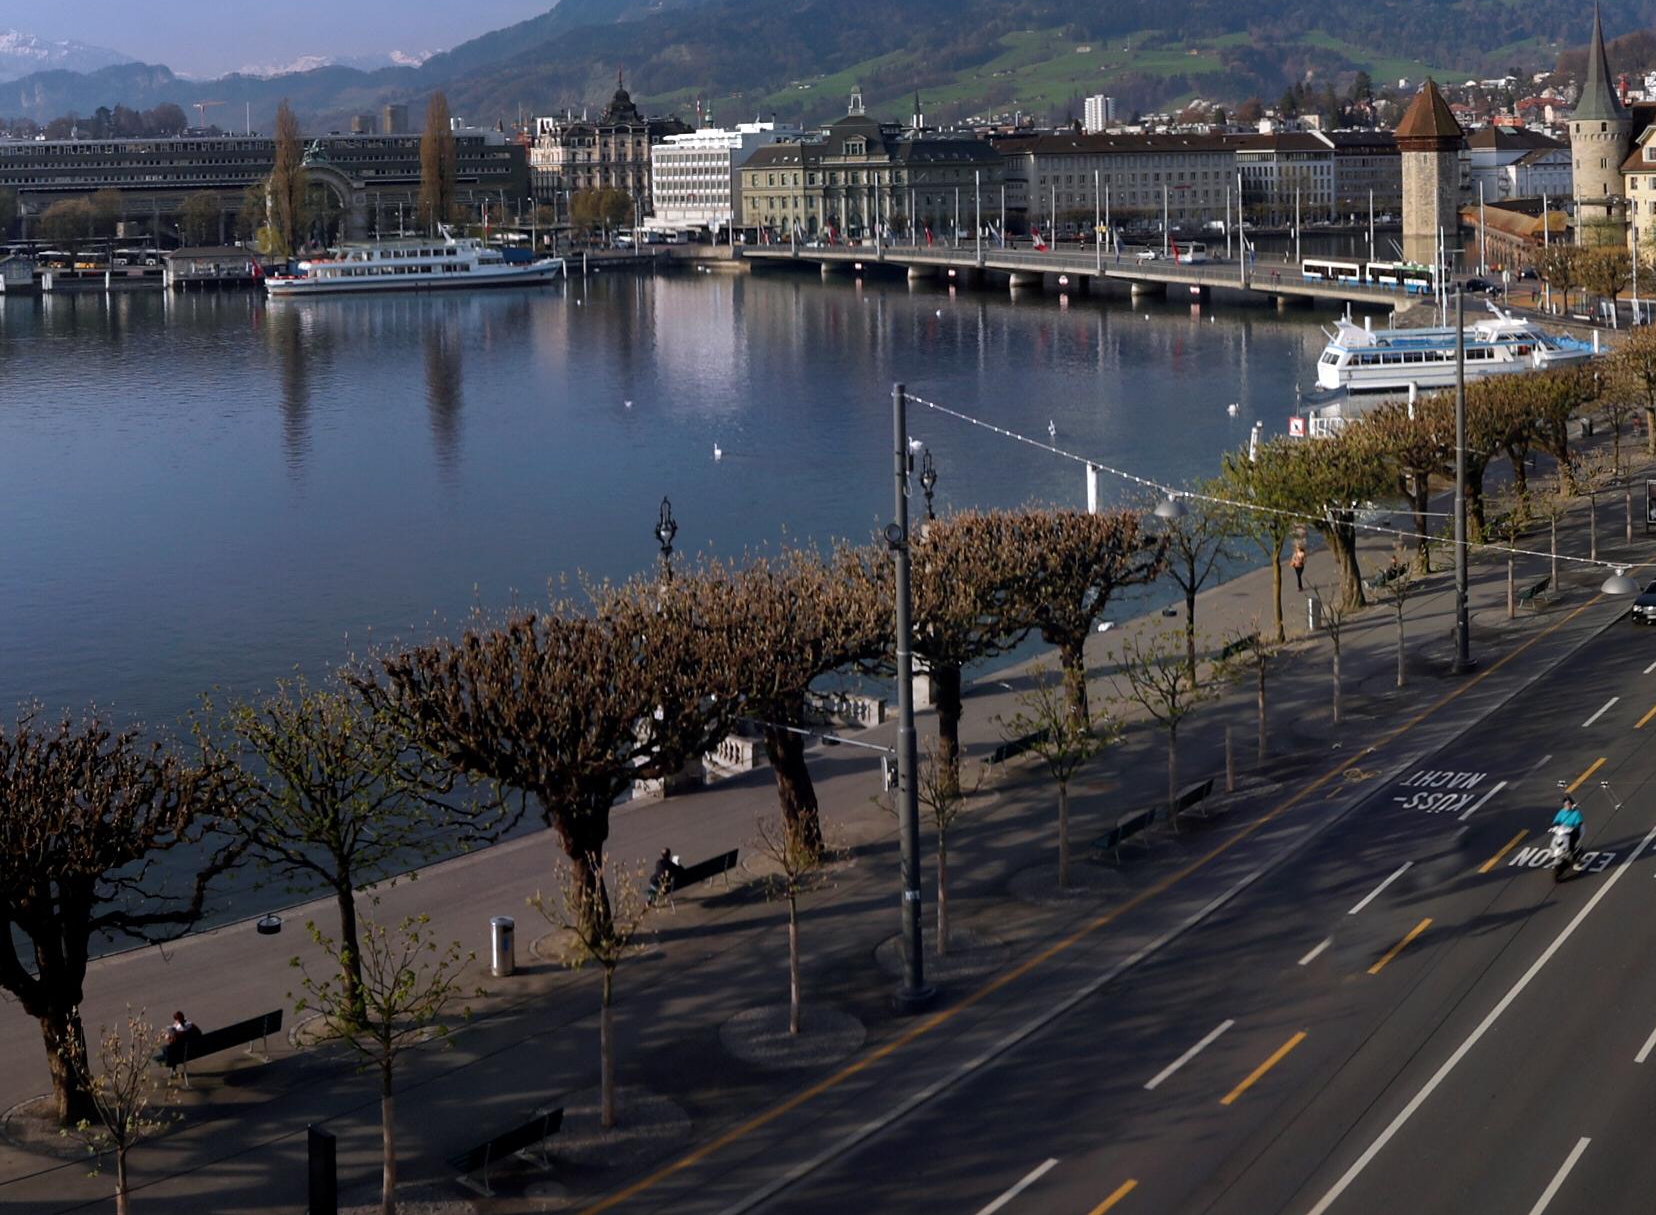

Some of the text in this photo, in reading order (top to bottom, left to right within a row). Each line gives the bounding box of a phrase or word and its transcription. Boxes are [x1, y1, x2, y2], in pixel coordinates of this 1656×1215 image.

[1400, 769, 1487, 789] NACHT
[1393, 791, 1475, 813] KÜSS-
[1508, 846, 1617, 873] EBON
